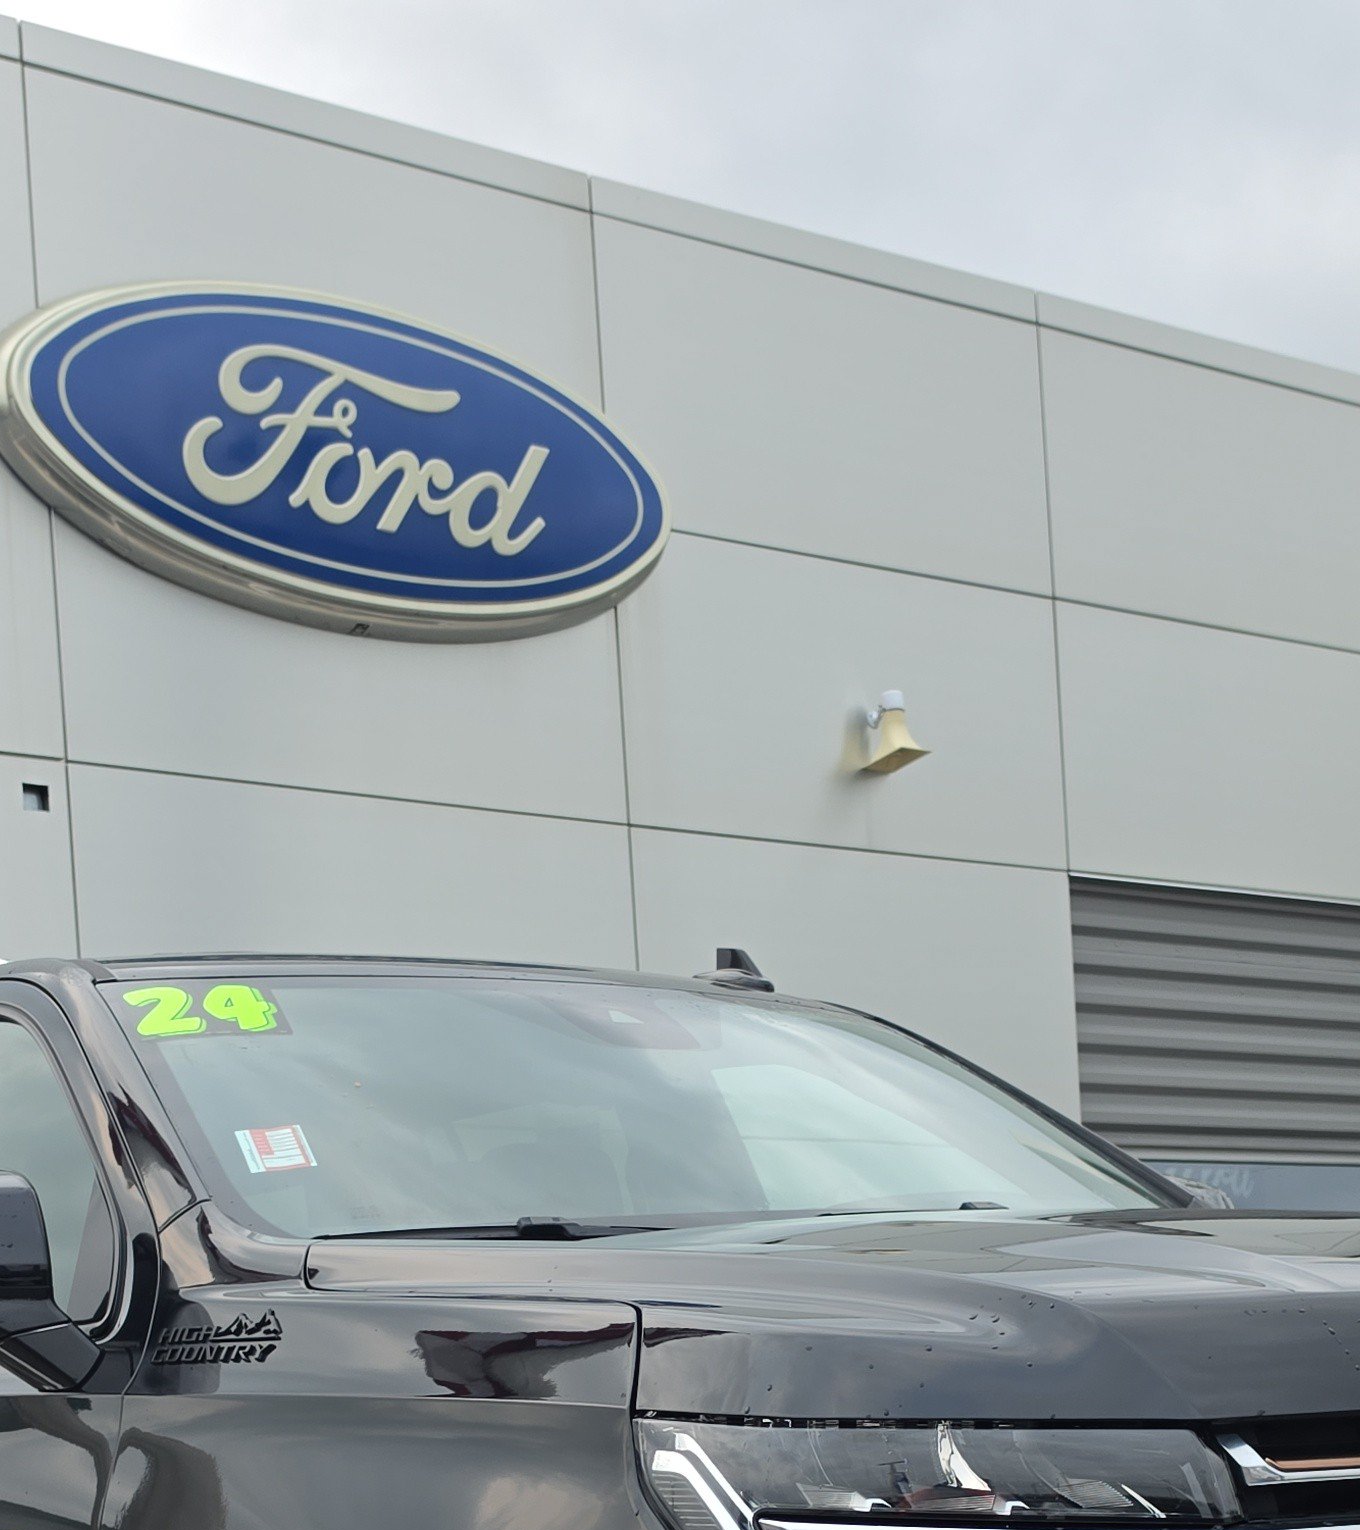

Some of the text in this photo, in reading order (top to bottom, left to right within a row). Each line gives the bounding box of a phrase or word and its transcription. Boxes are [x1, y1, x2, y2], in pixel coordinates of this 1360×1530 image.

[182, 343, 550, 557] Ford
[122, 983, 278, 1037] 24
[151, 1343, 277, 1365] COUNTRY
